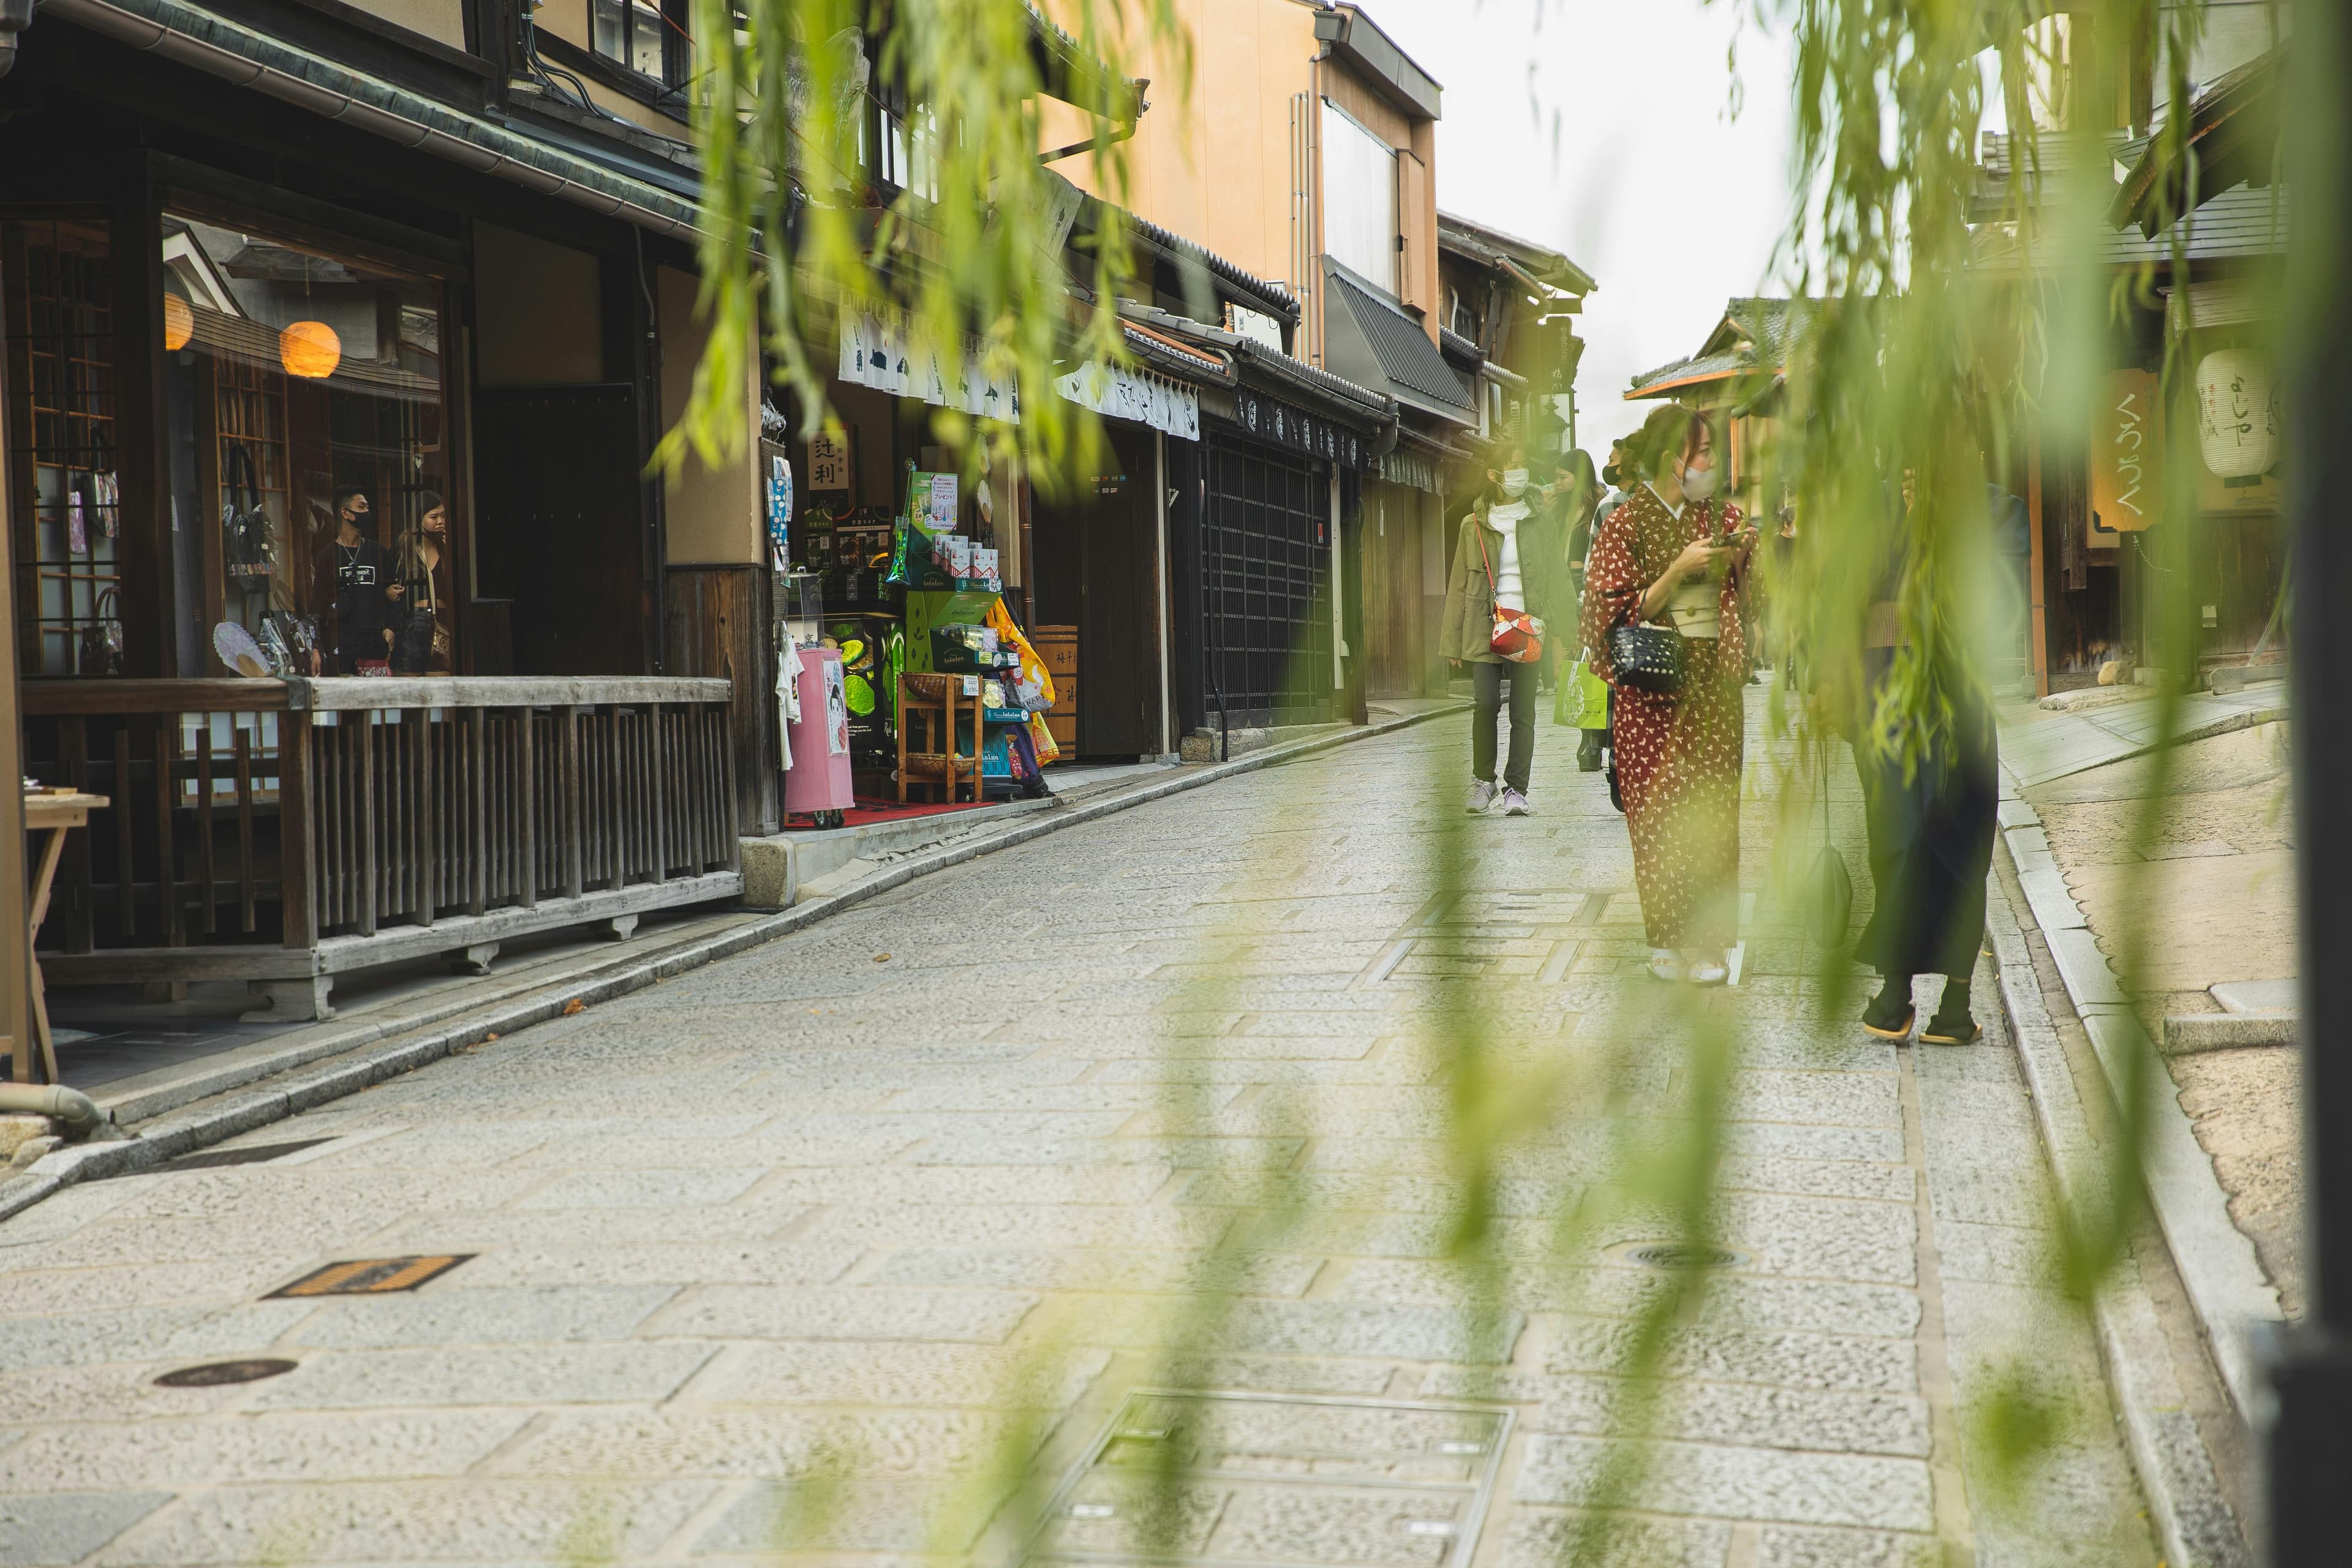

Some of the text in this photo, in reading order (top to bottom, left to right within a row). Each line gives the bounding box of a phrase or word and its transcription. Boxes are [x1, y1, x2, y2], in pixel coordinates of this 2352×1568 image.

[2224, 373, 2253, 447] よーじや
[814, 438, 835, 484] 辻利
[2115, 393, 2144, 516] くろちく
